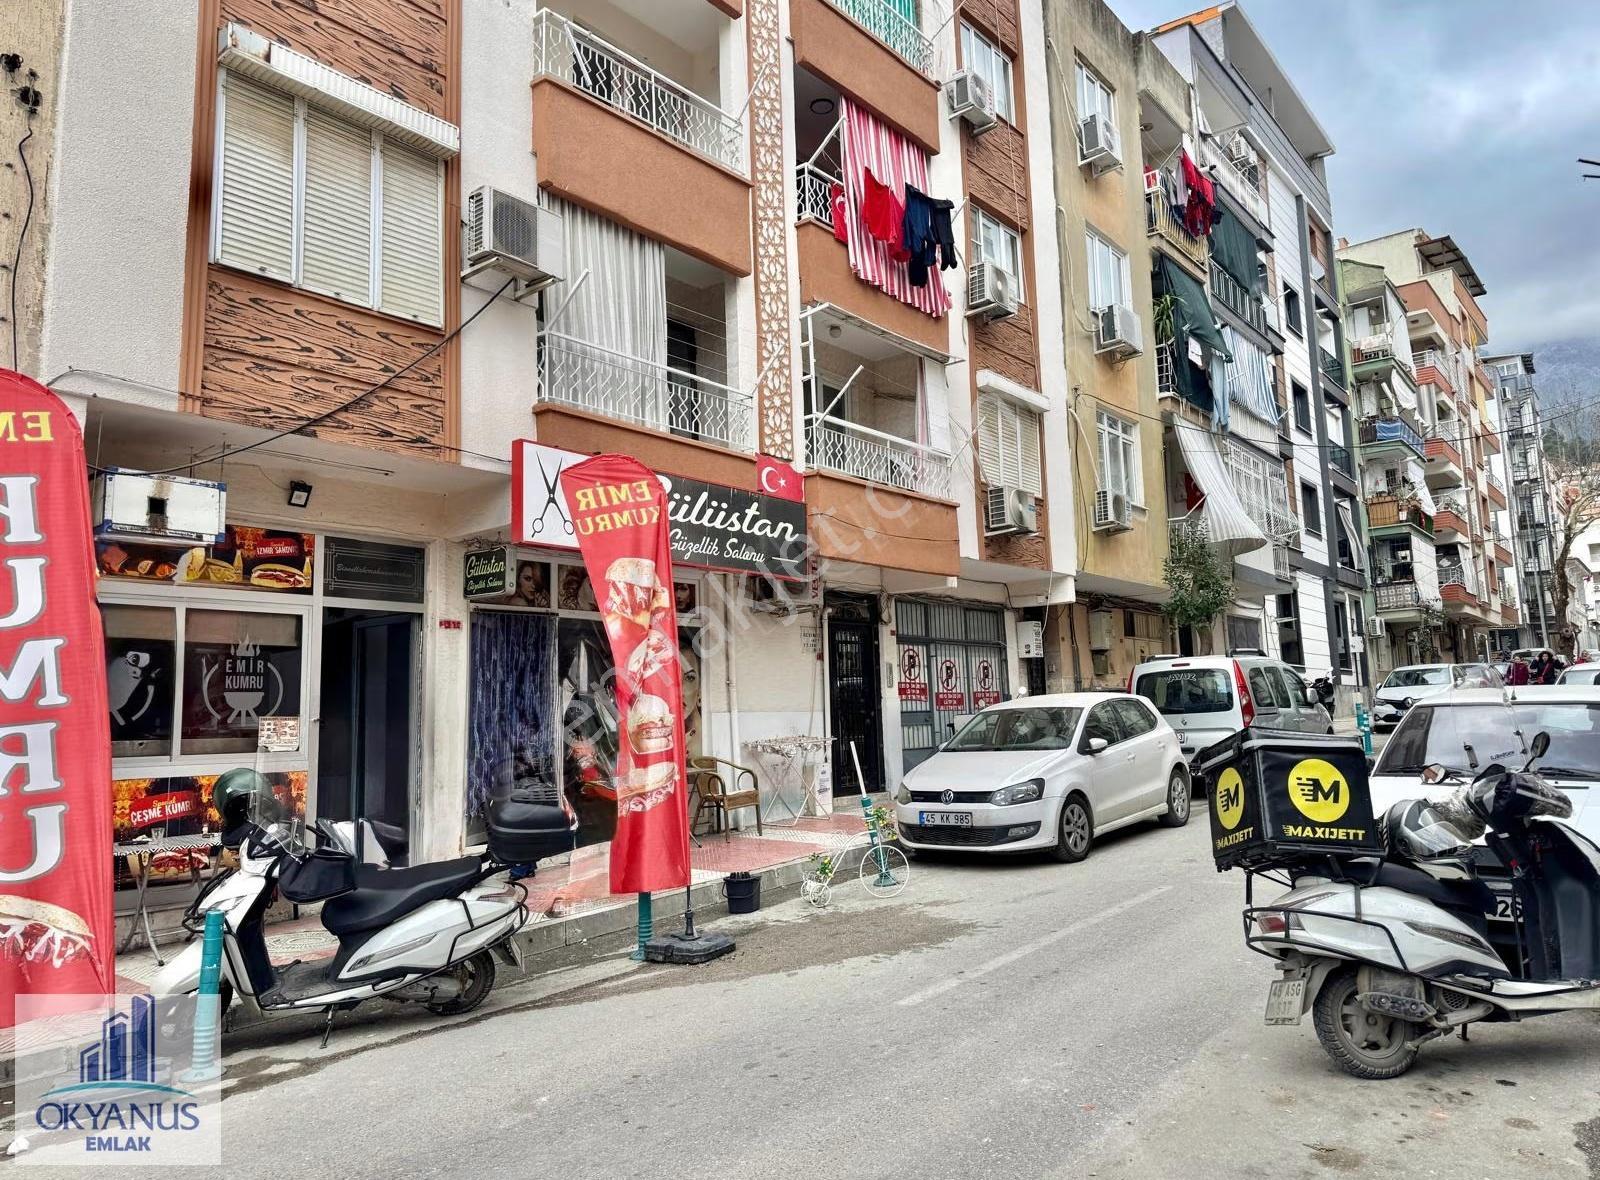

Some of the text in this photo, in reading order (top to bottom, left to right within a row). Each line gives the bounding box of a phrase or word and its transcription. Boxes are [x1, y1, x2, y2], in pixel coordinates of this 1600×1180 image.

[655, 474, 799, 542] ülüstan
[723, 537, 766, 563] Salonu
[225, 657, 264, 673] EMİR
[225, 675, 264, 689] KUMRU
[131, 799, 197, 826] ÇEŞME KUMR
[925, 813, 970, 825] 45 KK 985
[1216, 827, 1254, 849] MAXIJETT
[1286, 825, 1366, 841] MAXIJETT
